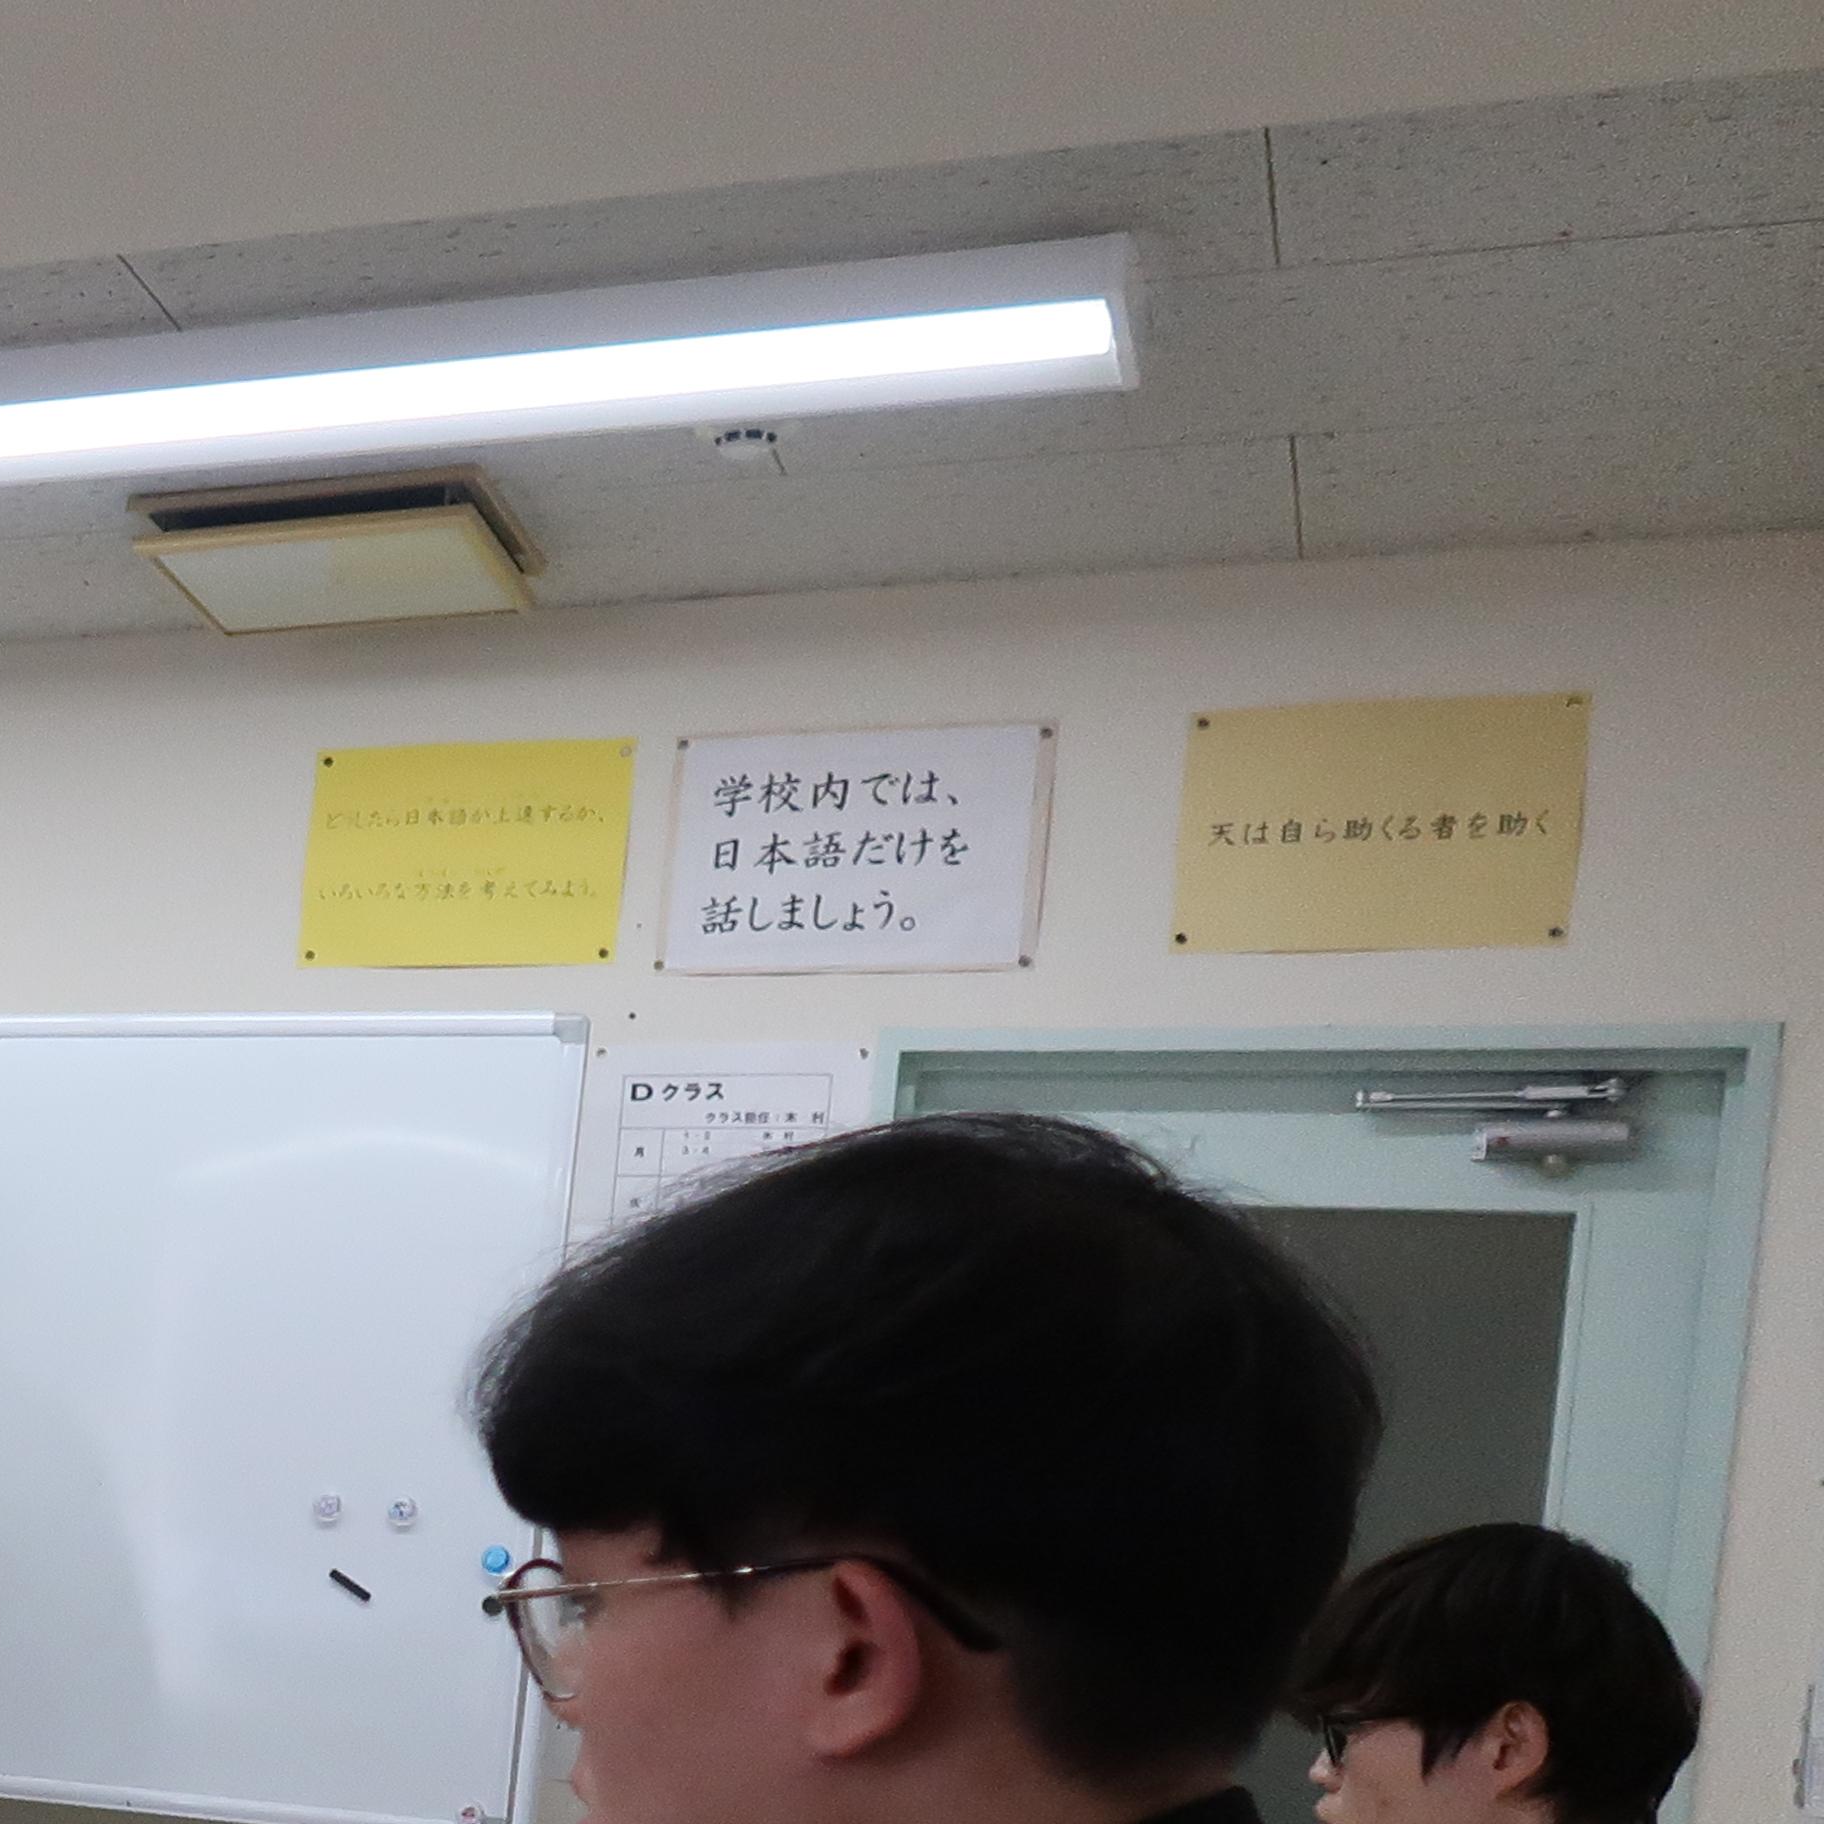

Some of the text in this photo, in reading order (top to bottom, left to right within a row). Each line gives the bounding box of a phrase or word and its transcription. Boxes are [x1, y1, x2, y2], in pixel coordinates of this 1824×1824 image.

[712, 768, 959, 819] 学校内では、
[712, 826, 972, 875] 日本語だけを
[1207, 808, 1550, 848] 天は自ら助くる者を助く
[701, 891, 918, 936] 話しましょう。
